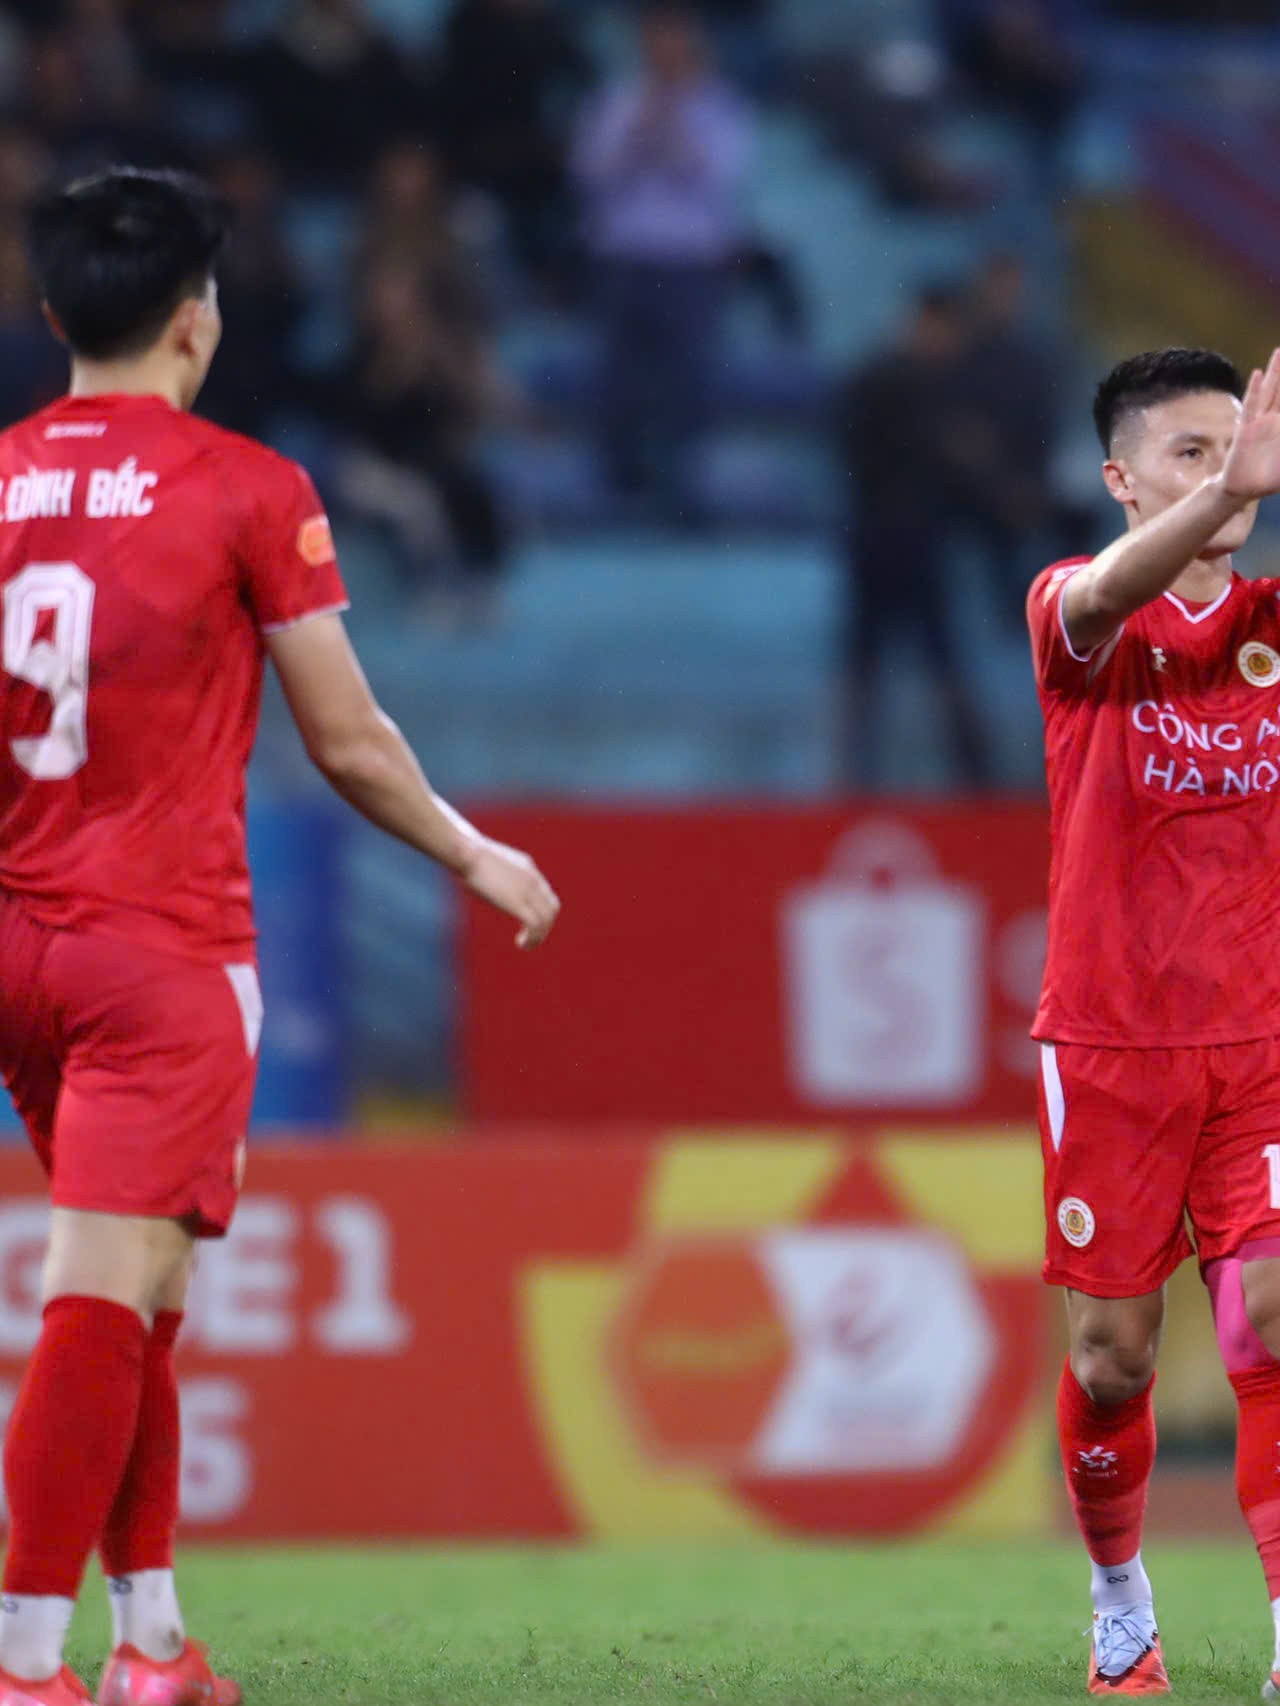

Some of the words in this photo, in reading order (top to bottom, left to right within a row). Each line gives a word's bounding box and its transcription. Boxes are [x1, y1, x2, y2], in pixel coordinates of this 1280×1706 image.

[2, 561, 95, 781] 9
[1132, 700, 1242, 751] CÔNG
[1144, 753, 1204, 796] HÀ
